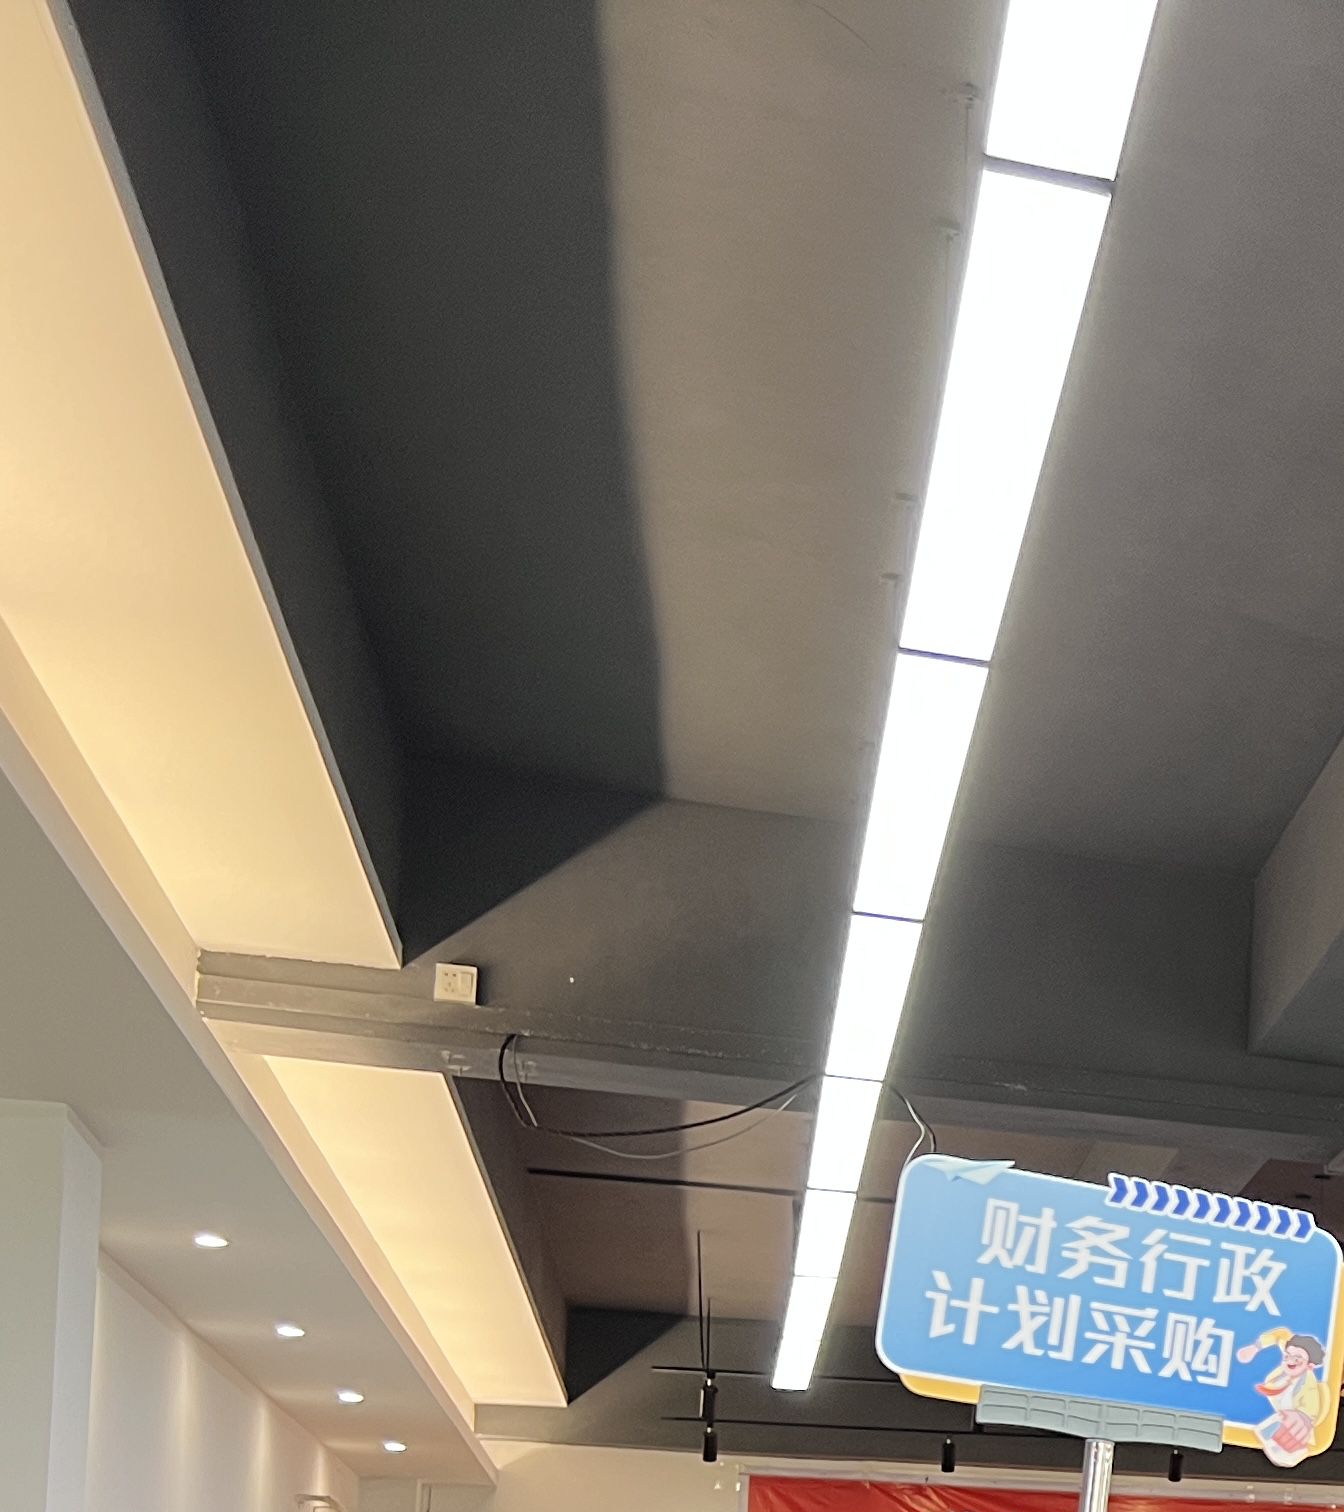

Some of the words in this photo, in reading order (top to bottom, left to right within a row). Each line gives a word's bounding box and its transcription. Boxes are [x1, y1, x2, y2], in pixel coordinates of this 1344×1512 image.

[976, 1198, 1288, 1317] 财务行政
[925, 1270, 1235, 1388] 计划采购
